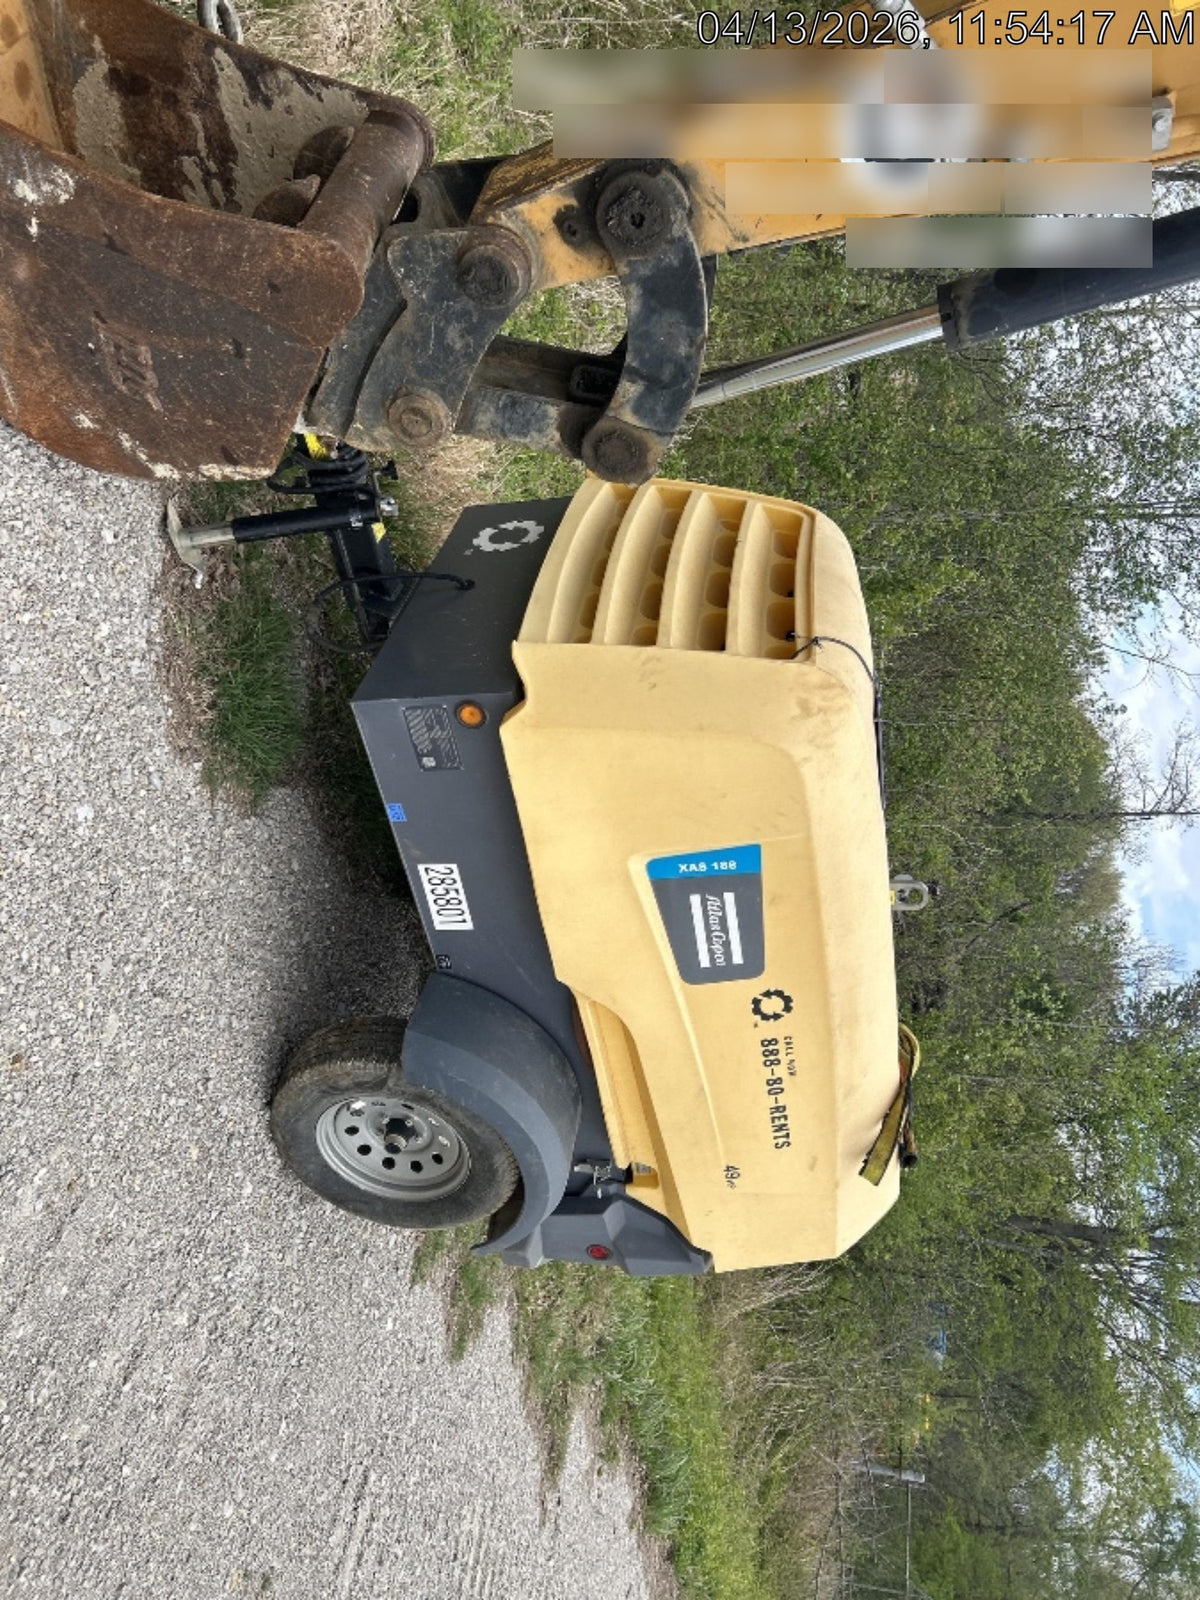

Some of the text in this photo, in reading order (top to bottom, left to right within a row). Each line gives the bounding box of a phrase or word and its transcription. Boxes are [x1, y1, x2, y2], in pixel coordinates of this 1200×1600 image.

[678, 862, 707, 874] XAS
[424, 866, 467, 925] 285801
[705, 893, 723, 931] Atlas
[760, 1037, 791, 1149] 888-80-RENTS
